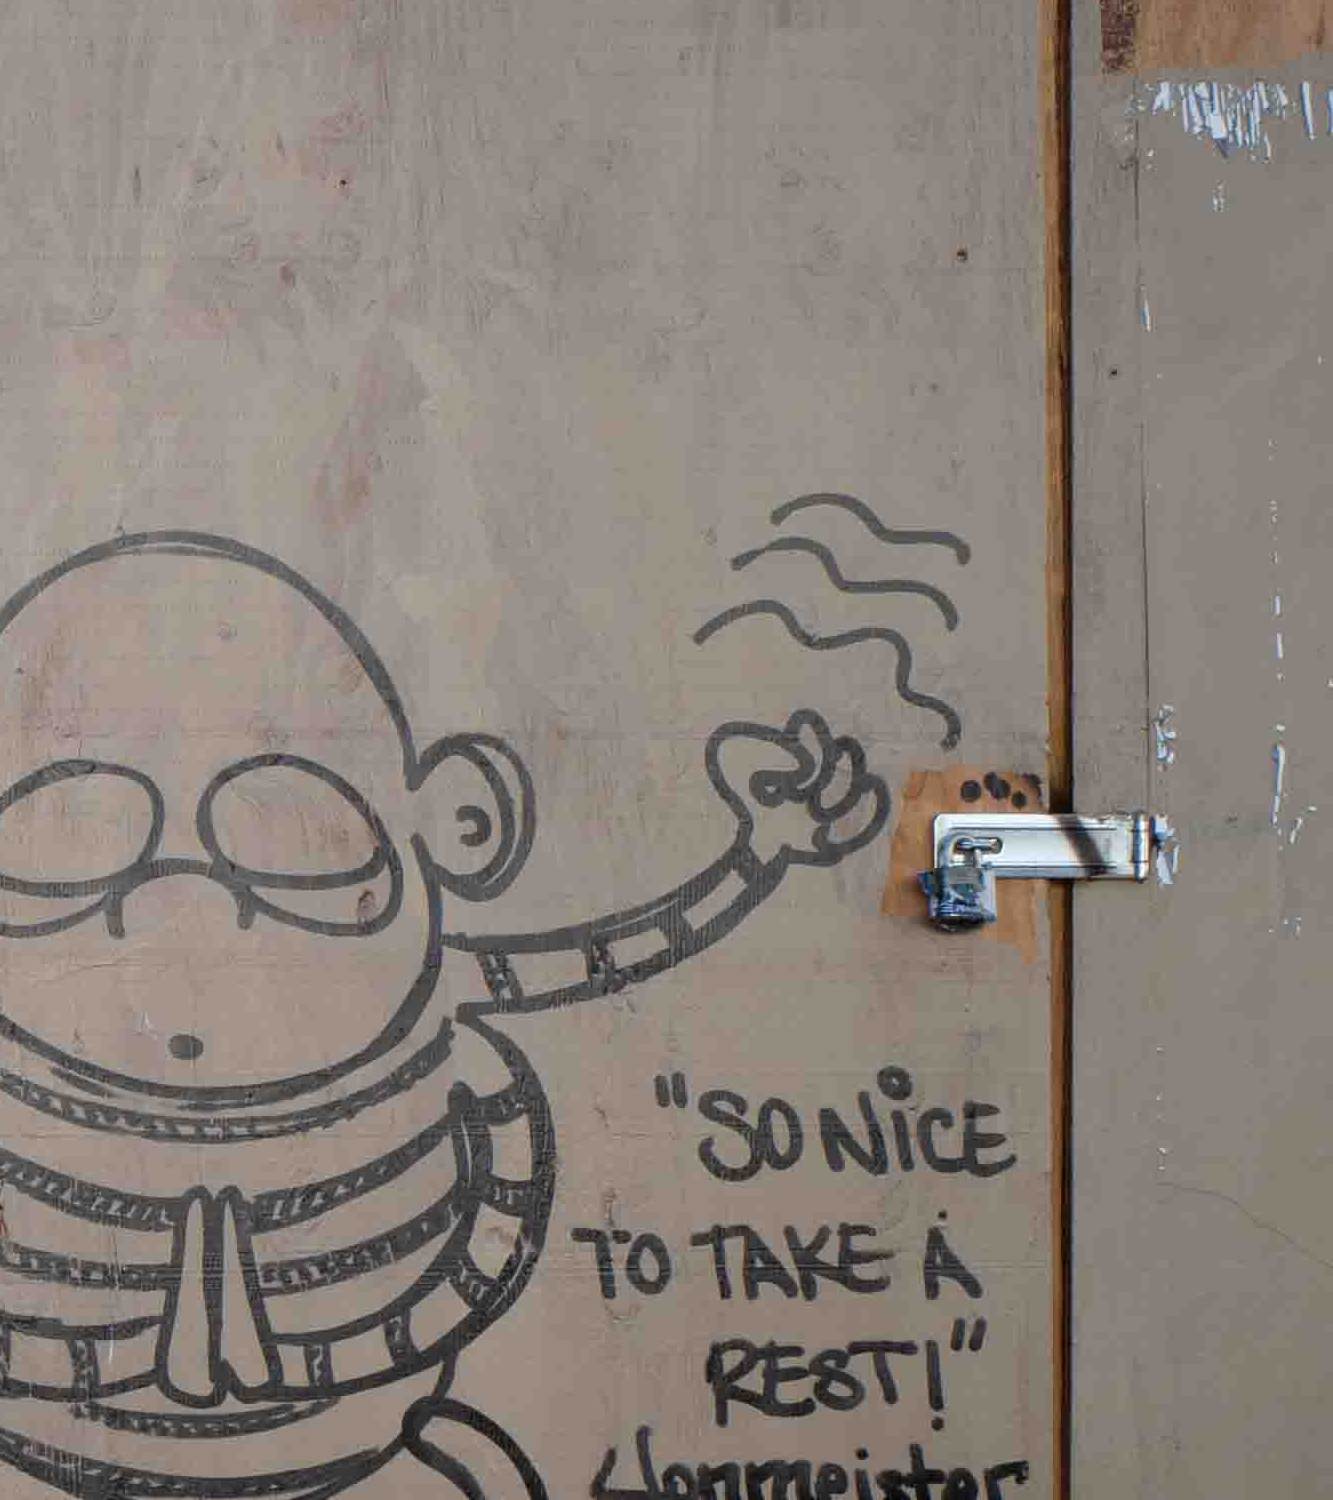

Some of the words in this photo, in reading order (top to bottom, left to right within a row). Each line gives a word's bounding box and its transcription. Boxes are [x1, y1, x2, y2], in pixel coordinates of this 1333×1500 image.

[570, 1226, 673, 1300] TO
[689, 1224, 897, 1301] TAKE
[923, 1222, 983, 1300] A
